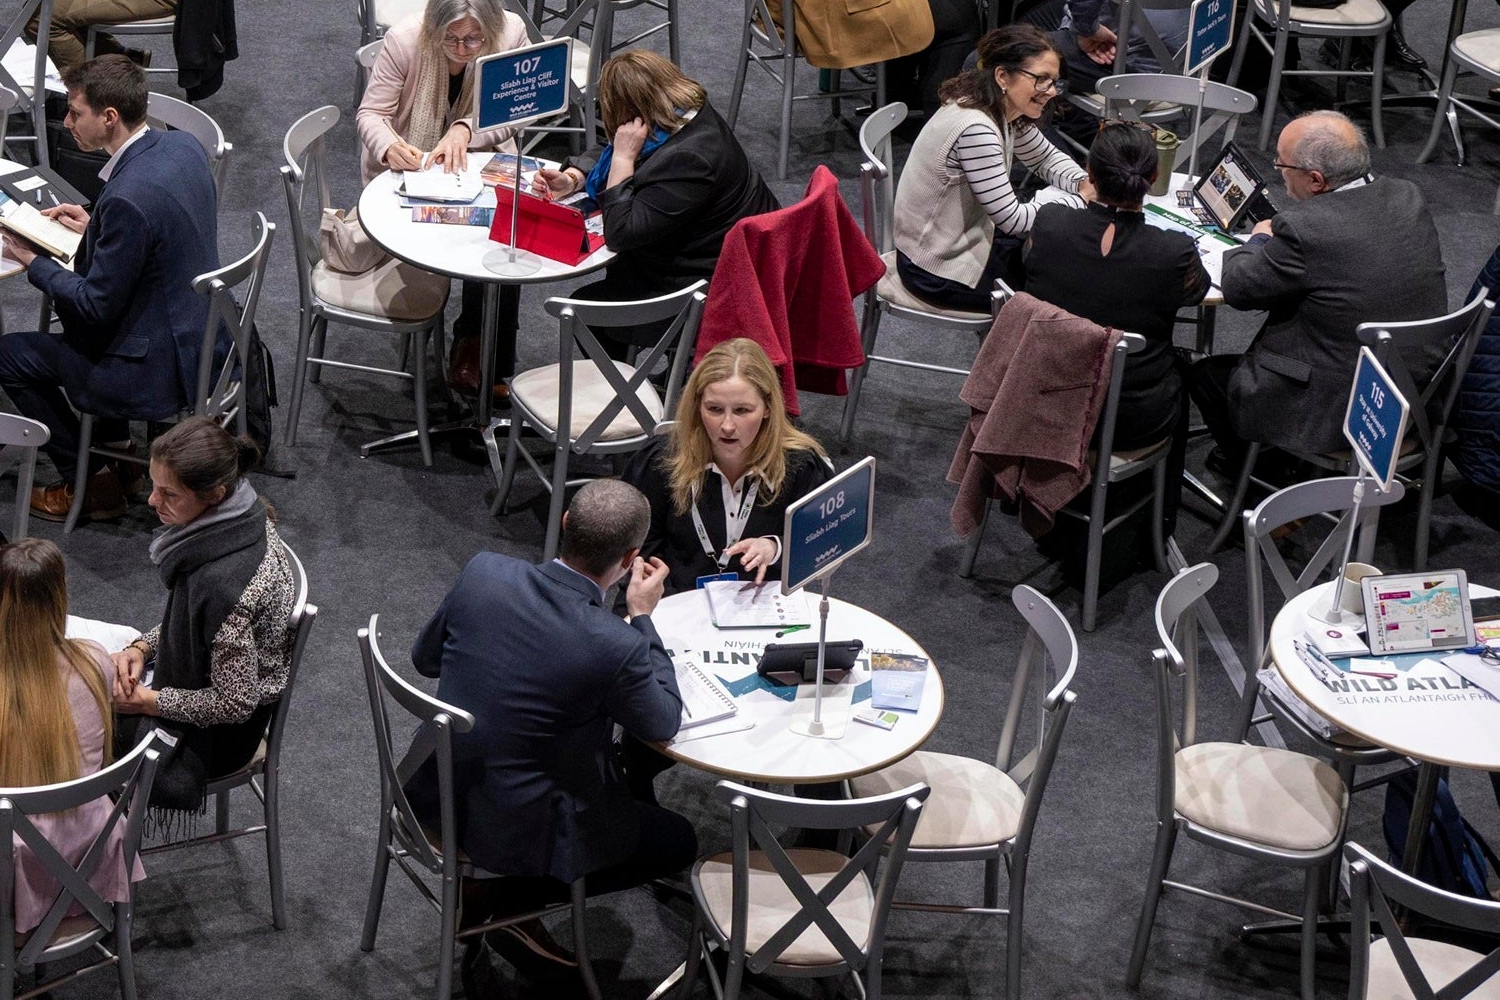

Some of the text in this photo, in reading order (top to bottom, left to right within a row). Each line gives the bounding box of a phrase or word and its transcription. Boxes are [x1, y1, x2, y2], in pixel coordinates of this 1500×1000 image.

[513, 56, 541, 75] 107
[492, 86, 529, 100] Experience
[537, 79, 559, 89] Visitor
[500, 71, 553, 91] Sliabh Liag Cliff
[514, 91, 537, 102] Centre
[1162, 212, 1178, 223] Map
[1188, 224, 1217, 238] Ireland
[1370, 382, 1385, 409] 115
[1366, 419, 1379, 440] Galway
[1370, 410, 1387, 438] University
[819, 491, 845, 520] 108
[804, 508, 857, 544] Sliabh Liag Tours
[1324, 678, 1398, 693] WILD
[1361, 696, 1380, 704] AN
[1384, 693, 1467, 704] ATLANTAIGH
